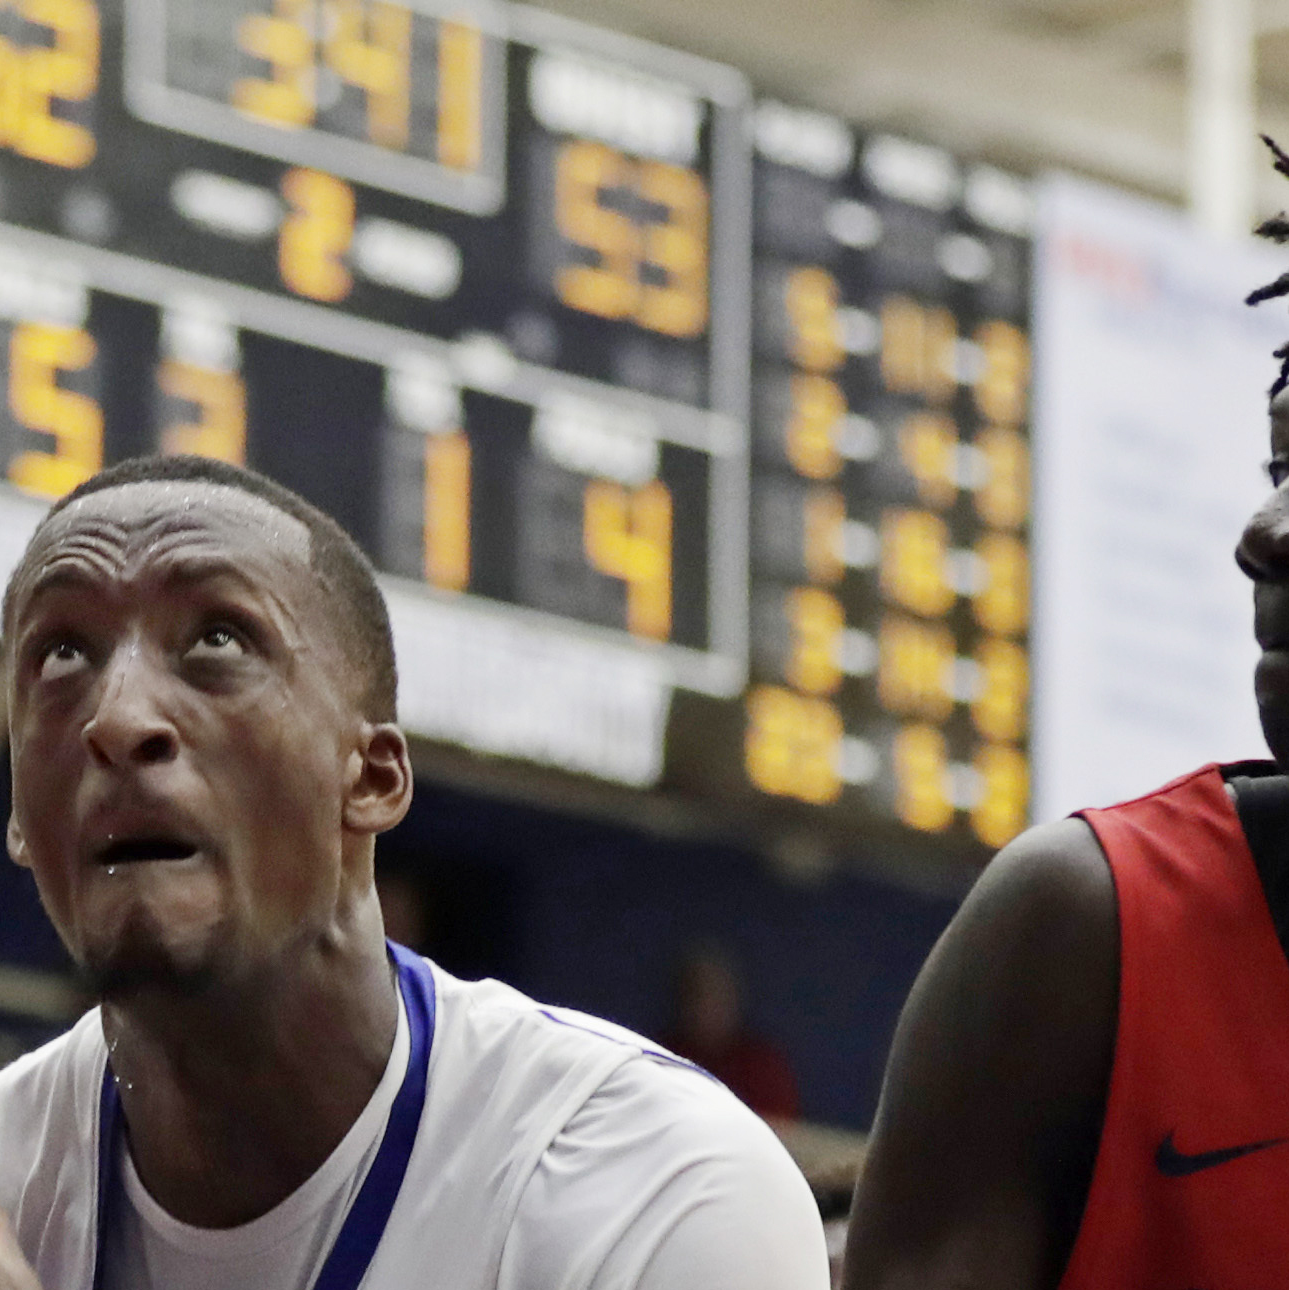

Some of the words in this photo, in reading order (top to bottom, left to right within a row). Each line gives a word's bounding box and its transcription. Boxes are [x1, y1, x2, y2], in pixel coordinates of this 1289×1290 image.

[279, 167, 355, 301] 2
[552, 141, 709, 339] 53
[8, 322, 105, 500] 5
[583, 478, 673, 642] 4
